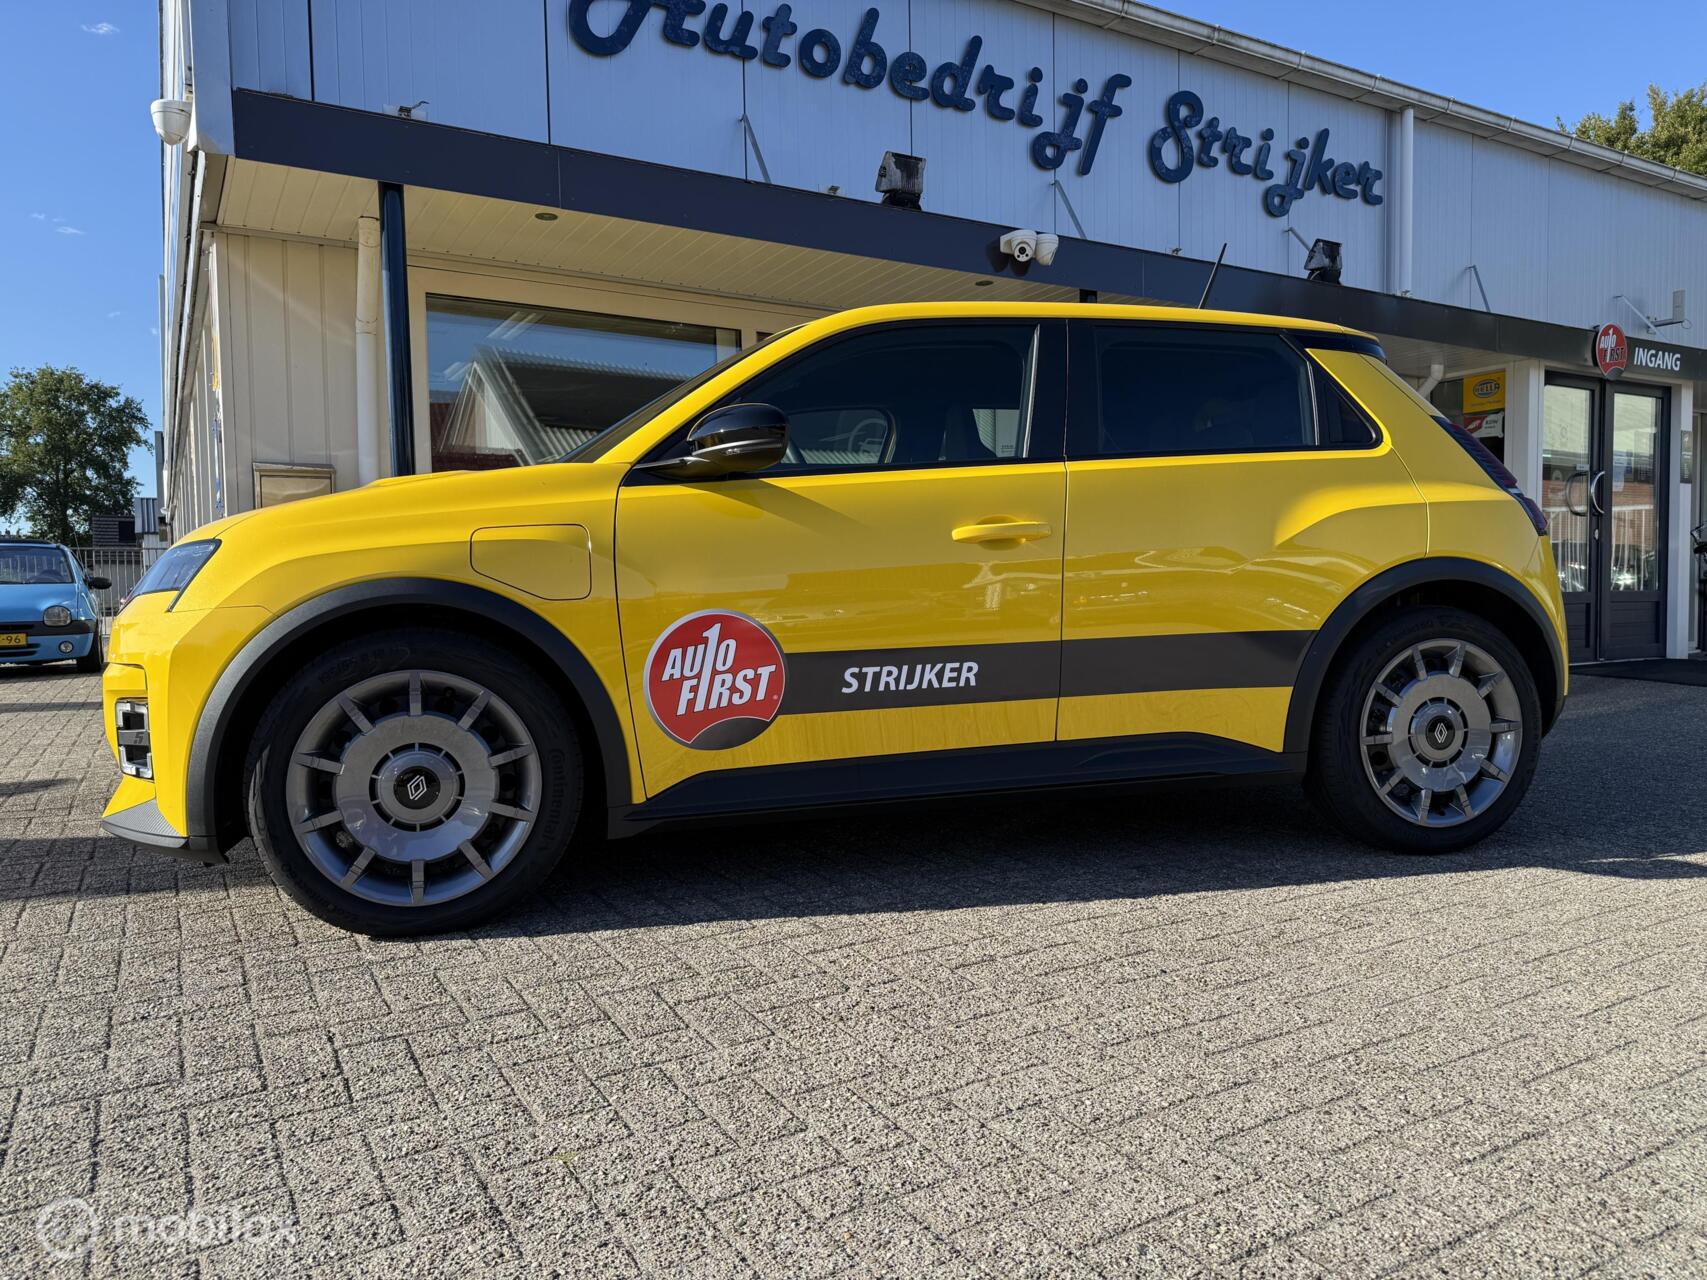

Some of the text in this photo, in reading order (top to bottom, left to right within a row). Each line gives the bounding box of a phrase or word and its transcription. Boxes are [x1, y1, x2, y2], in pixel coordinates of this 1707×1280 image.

[1150, 90, 1384, 218] Strijker
[1633, 347, 1681, 371] INGANG
[841, 661, 979, 694] STRIJKER
